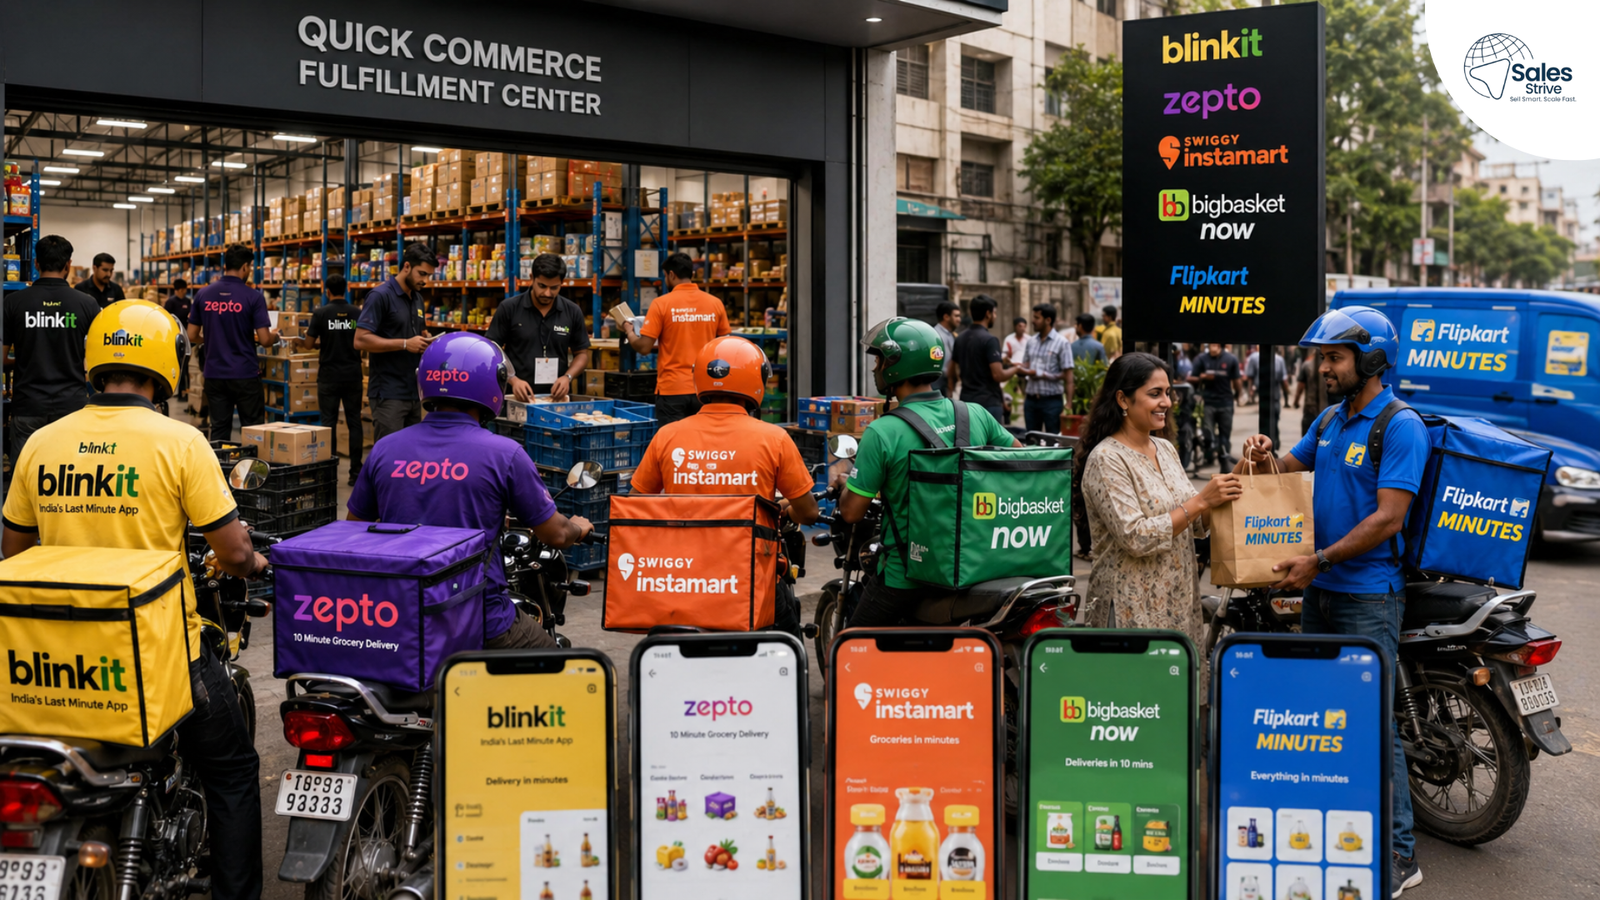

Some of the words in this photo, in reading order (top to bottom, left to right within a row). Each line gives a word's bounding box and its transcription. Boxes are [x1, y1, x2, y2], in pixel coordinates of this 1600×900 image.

[298, 15, 414, 59] QUICK
[423, 33, 602, 82] COMMERCE
[1162, 27, 1263, 64] blinkit
[299, 59, 495, 104] FULFILLMENT
[501, 83, 602, 115] CENTER
[1163, 83, 1261, 120] zepto
[1184, 134, 1240, 147] SWIGGY
[1184, 145, 1289, 167] instamart
[1192, 193, 1285, 219] bigbasket
[1200, 222, 1255, 240] now
[1170, 265, 1249, 290] Flipkart
[204, 300, 243, 314] zepto
[1179, 296, 1266, 315] MINUTES
[25, 311, 77, 328] blinkit
[672, 312, 716, 323] instamart
[103, 332, 143, 347] blinkit
[1437, 323, 1509, 345] Flipkart
[1406, 349, 1508, 372] MINUTES
[426, 368, 469, 385] zepto
[688, 450, 736, 460] SWIGGY
[38, 464, 139, 498] blinkit
[390, 458, 469, 485] zepto
[673, 468, 758, 486] instamart
[998, 496, 1064, 518] bigbasket
[1442, 485, 1509, 513] Flipkart
[39, 504, 63, 513] India's
[65, 504, 84, 513] Last
[85, 504, 116, 514] Minute
[118, 504, 139, 516] App
[1245, 515, 1291, 531] Flipkart
[1437, 511, 1524, 542] MINUTES
[991, 525, 1051, 550] now
[1245, 531, 1303, 545] MINUTES
[638, 557, 694, 568] SWIGGY
[636, 571, 738, 594] instamart
[293, 593, 399, 632] zepto
[293, 633, 303, 642] 10
[304, 633, 331, 645] Minute
[332, 635, 364, 649] Grocery
[365, 639, 399, 652] Delivery
[8, 649, 127, 692] blinkit
[876, 688, 929, 698] SWIGGY
[11, 693, 42, 705] India's
[44, 696, 66, 707] Last
[68, 698, 104, 710] Minute
[106, 700, 128, 713] App
[684, 696, 753, 721] zepto
[875, 700, 974, 719] instamart
[1087, 701, 1160, 722] bigbasket
[487, 704, 566, 728] blinkit
[1253, 708, 1320, 729] Flipkart
[480, 737, 506, 746] India's
[526, 737, 554, 745] Minute
[556, 737, 573, 746] App
[707, 731, 737, 739] Grocery
[739, 730, 769, 739] Delivery
[870, 735, 912, 744] Groceries
[914, 735, 923, 744] in
[924, 735, 960, 745] minutes
[1090, 725, 1139, 741] now
[1256, 733, 1343, 753] MINUTES
[1065, 758, 1108, 767] Deliveries
[1109, 759, 1118, 767] in
[1119, 759, 1131, 768] 10
[1132, 760, 1154, 769] mins
[486, 776, 521, 786] Delivery
[523, 776, 532, 784] in
[533, 776, 568, 784] minutes
[1250, 771, 1299, 783] Everything
[1300, 773, 1310, 782] in
[1311, 773, 1349, 783] minutes
